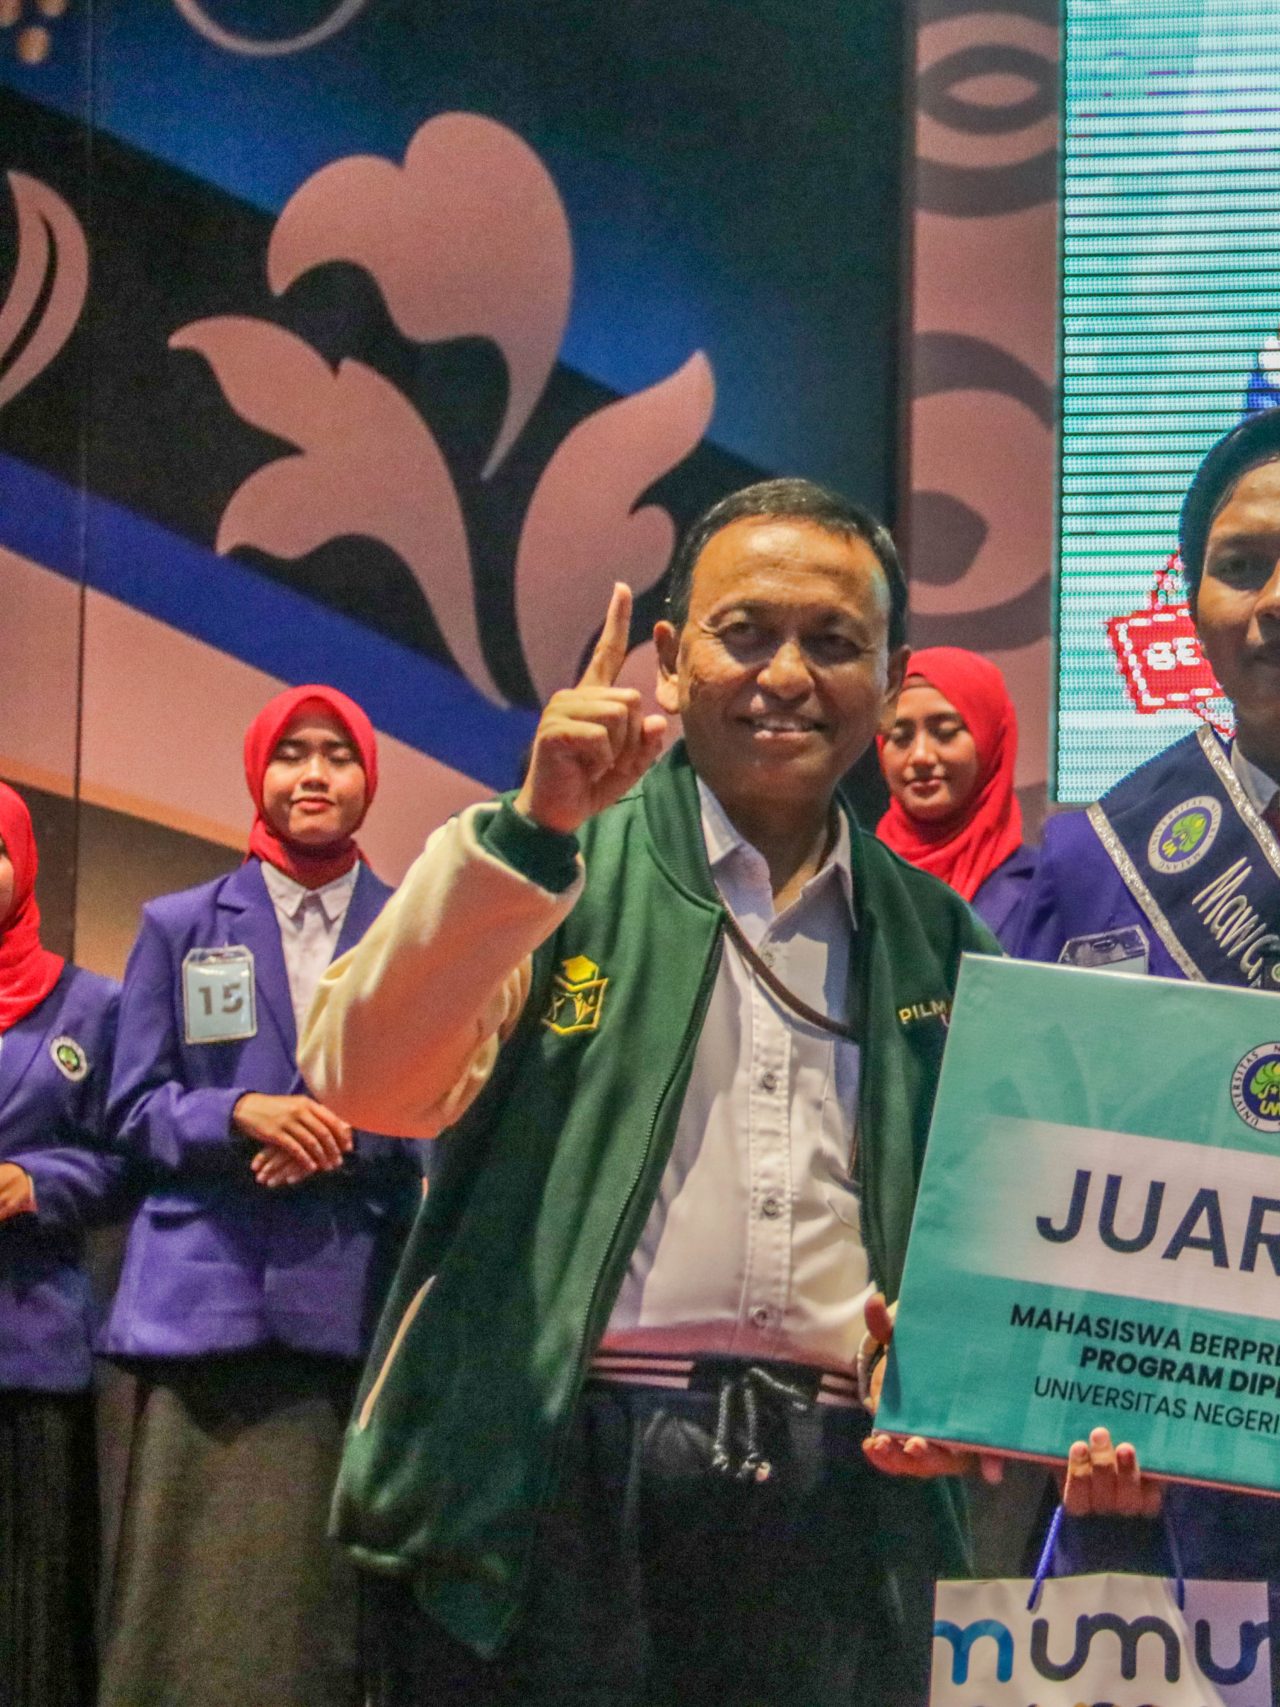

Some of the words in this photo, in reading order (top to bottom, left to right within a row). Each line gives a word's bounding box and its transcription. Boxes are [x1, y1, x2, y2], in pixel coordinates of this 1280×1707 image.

[1191, 856, 1280, 980] Mawa
[198, 983, 244, 1016] 15
[898, 1000, 950, 1025] PILM
[1010, 1303, 1182, 1351] MAHASISWA
[1079, 1345, 1225, 1390] PROGRAM
[1033, 1375, 1188, 1420] UNIVERSITAS
[1193, 1401, 1280, 1435] NEGERI
